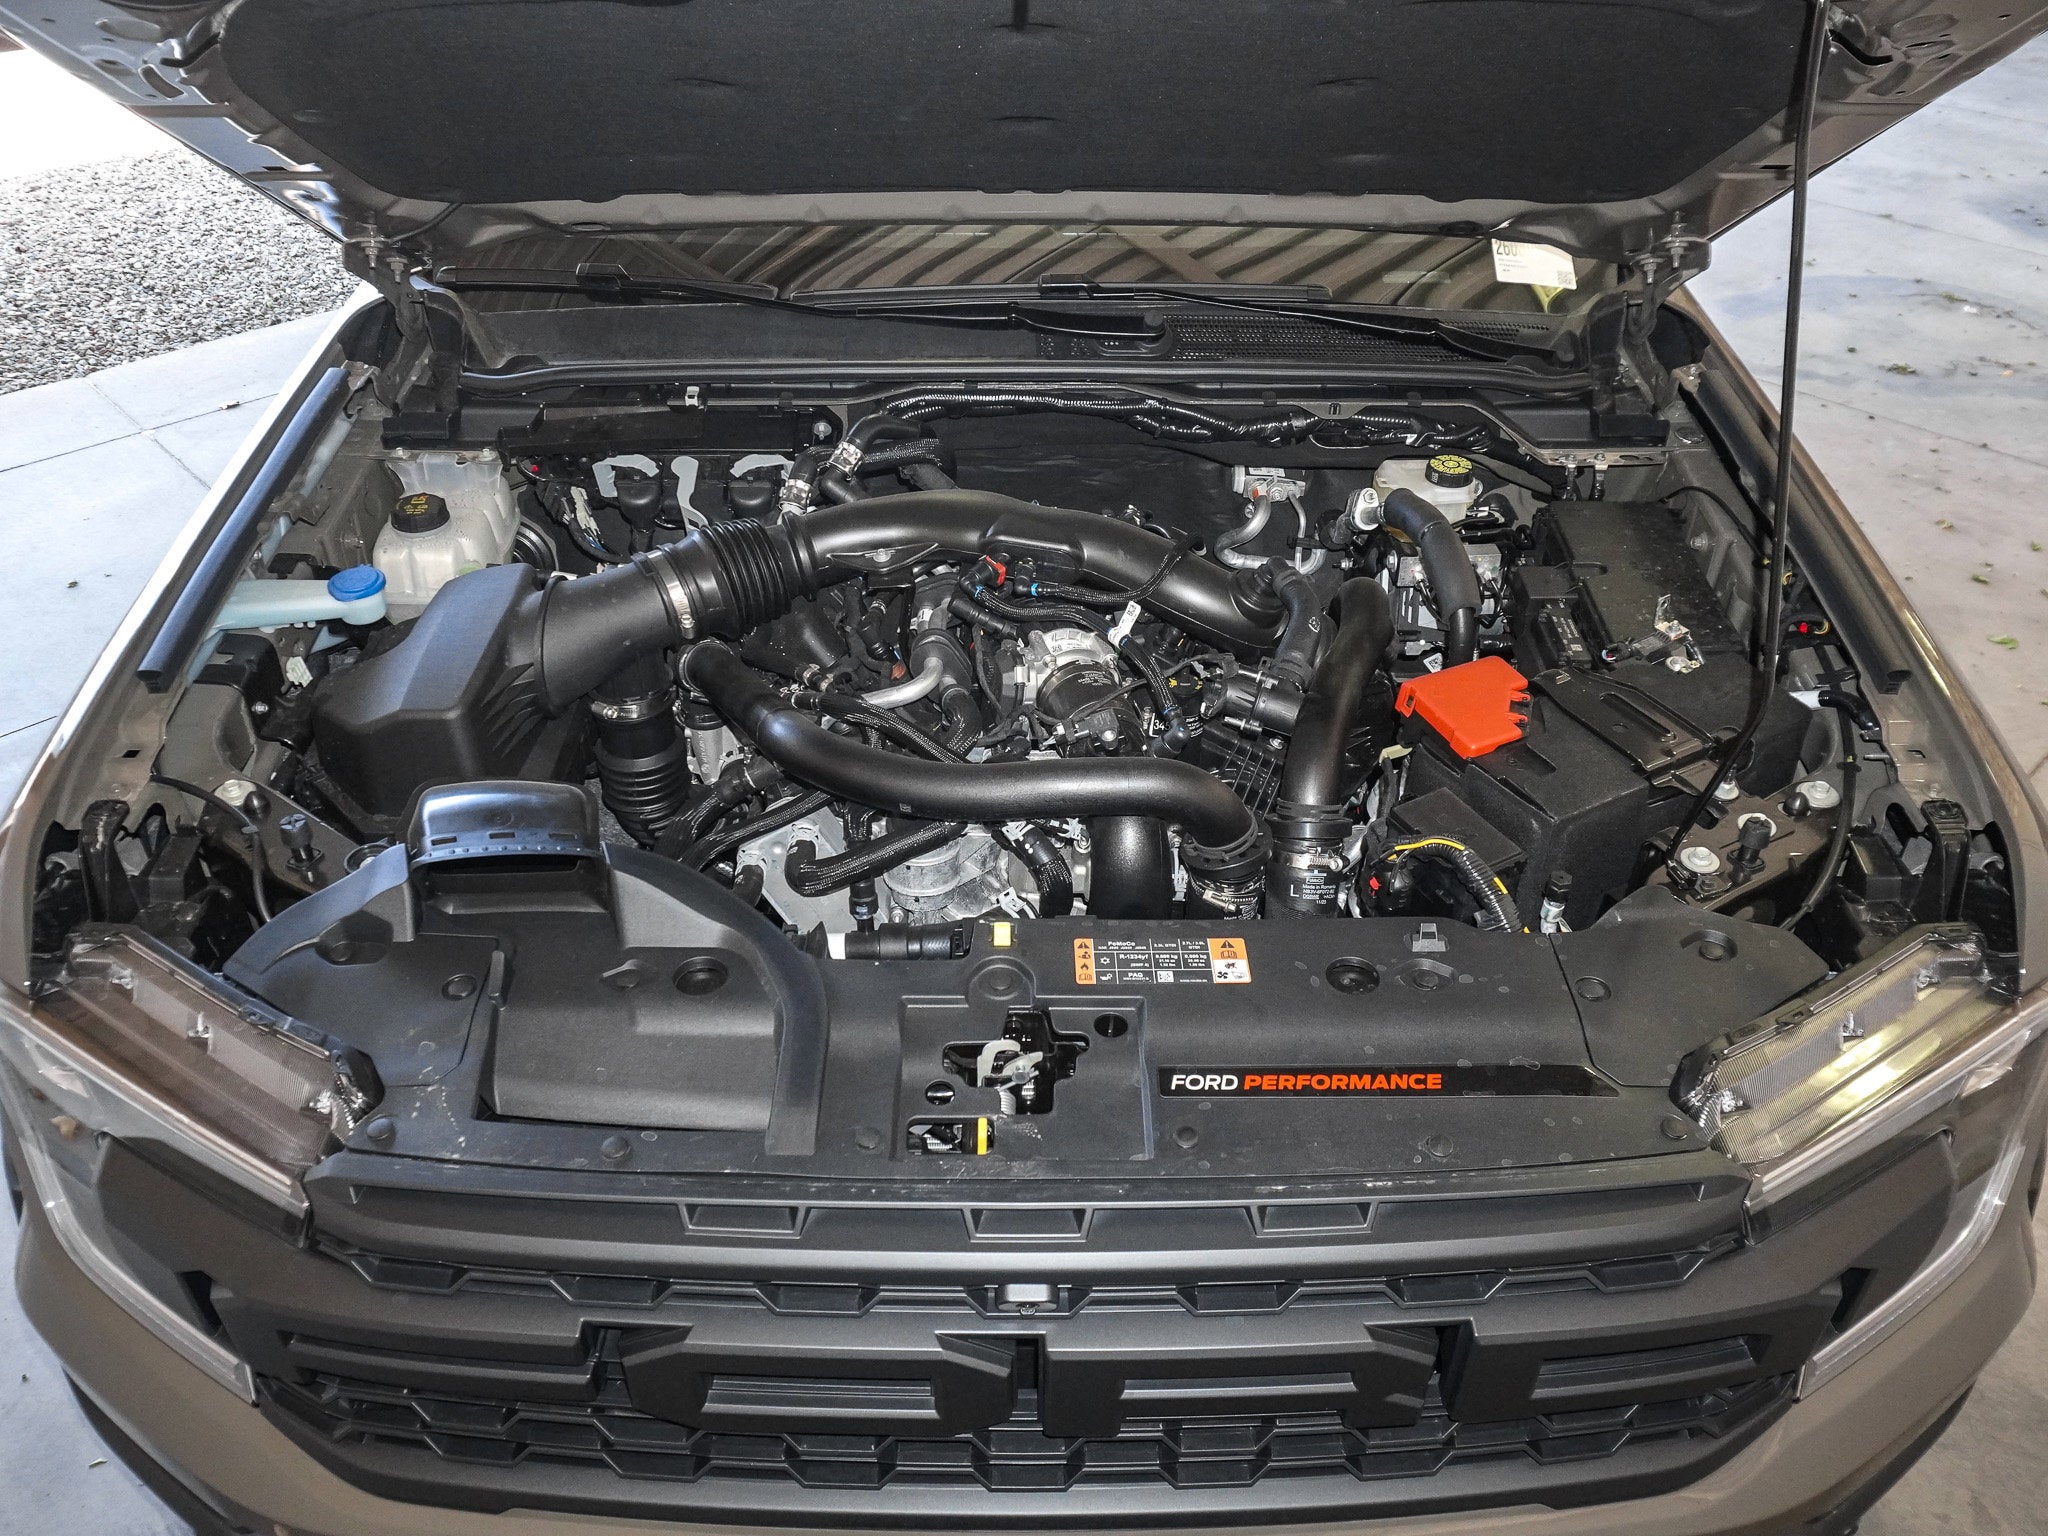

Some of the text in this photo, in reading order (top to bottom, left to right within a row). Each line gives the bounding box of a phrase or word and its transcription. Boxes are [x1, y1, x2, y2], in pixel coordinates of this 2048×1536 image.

[1290, 884, 1299, 897] L
[1170, 1074, 1442, 1090] FORD PERFORMANCE
